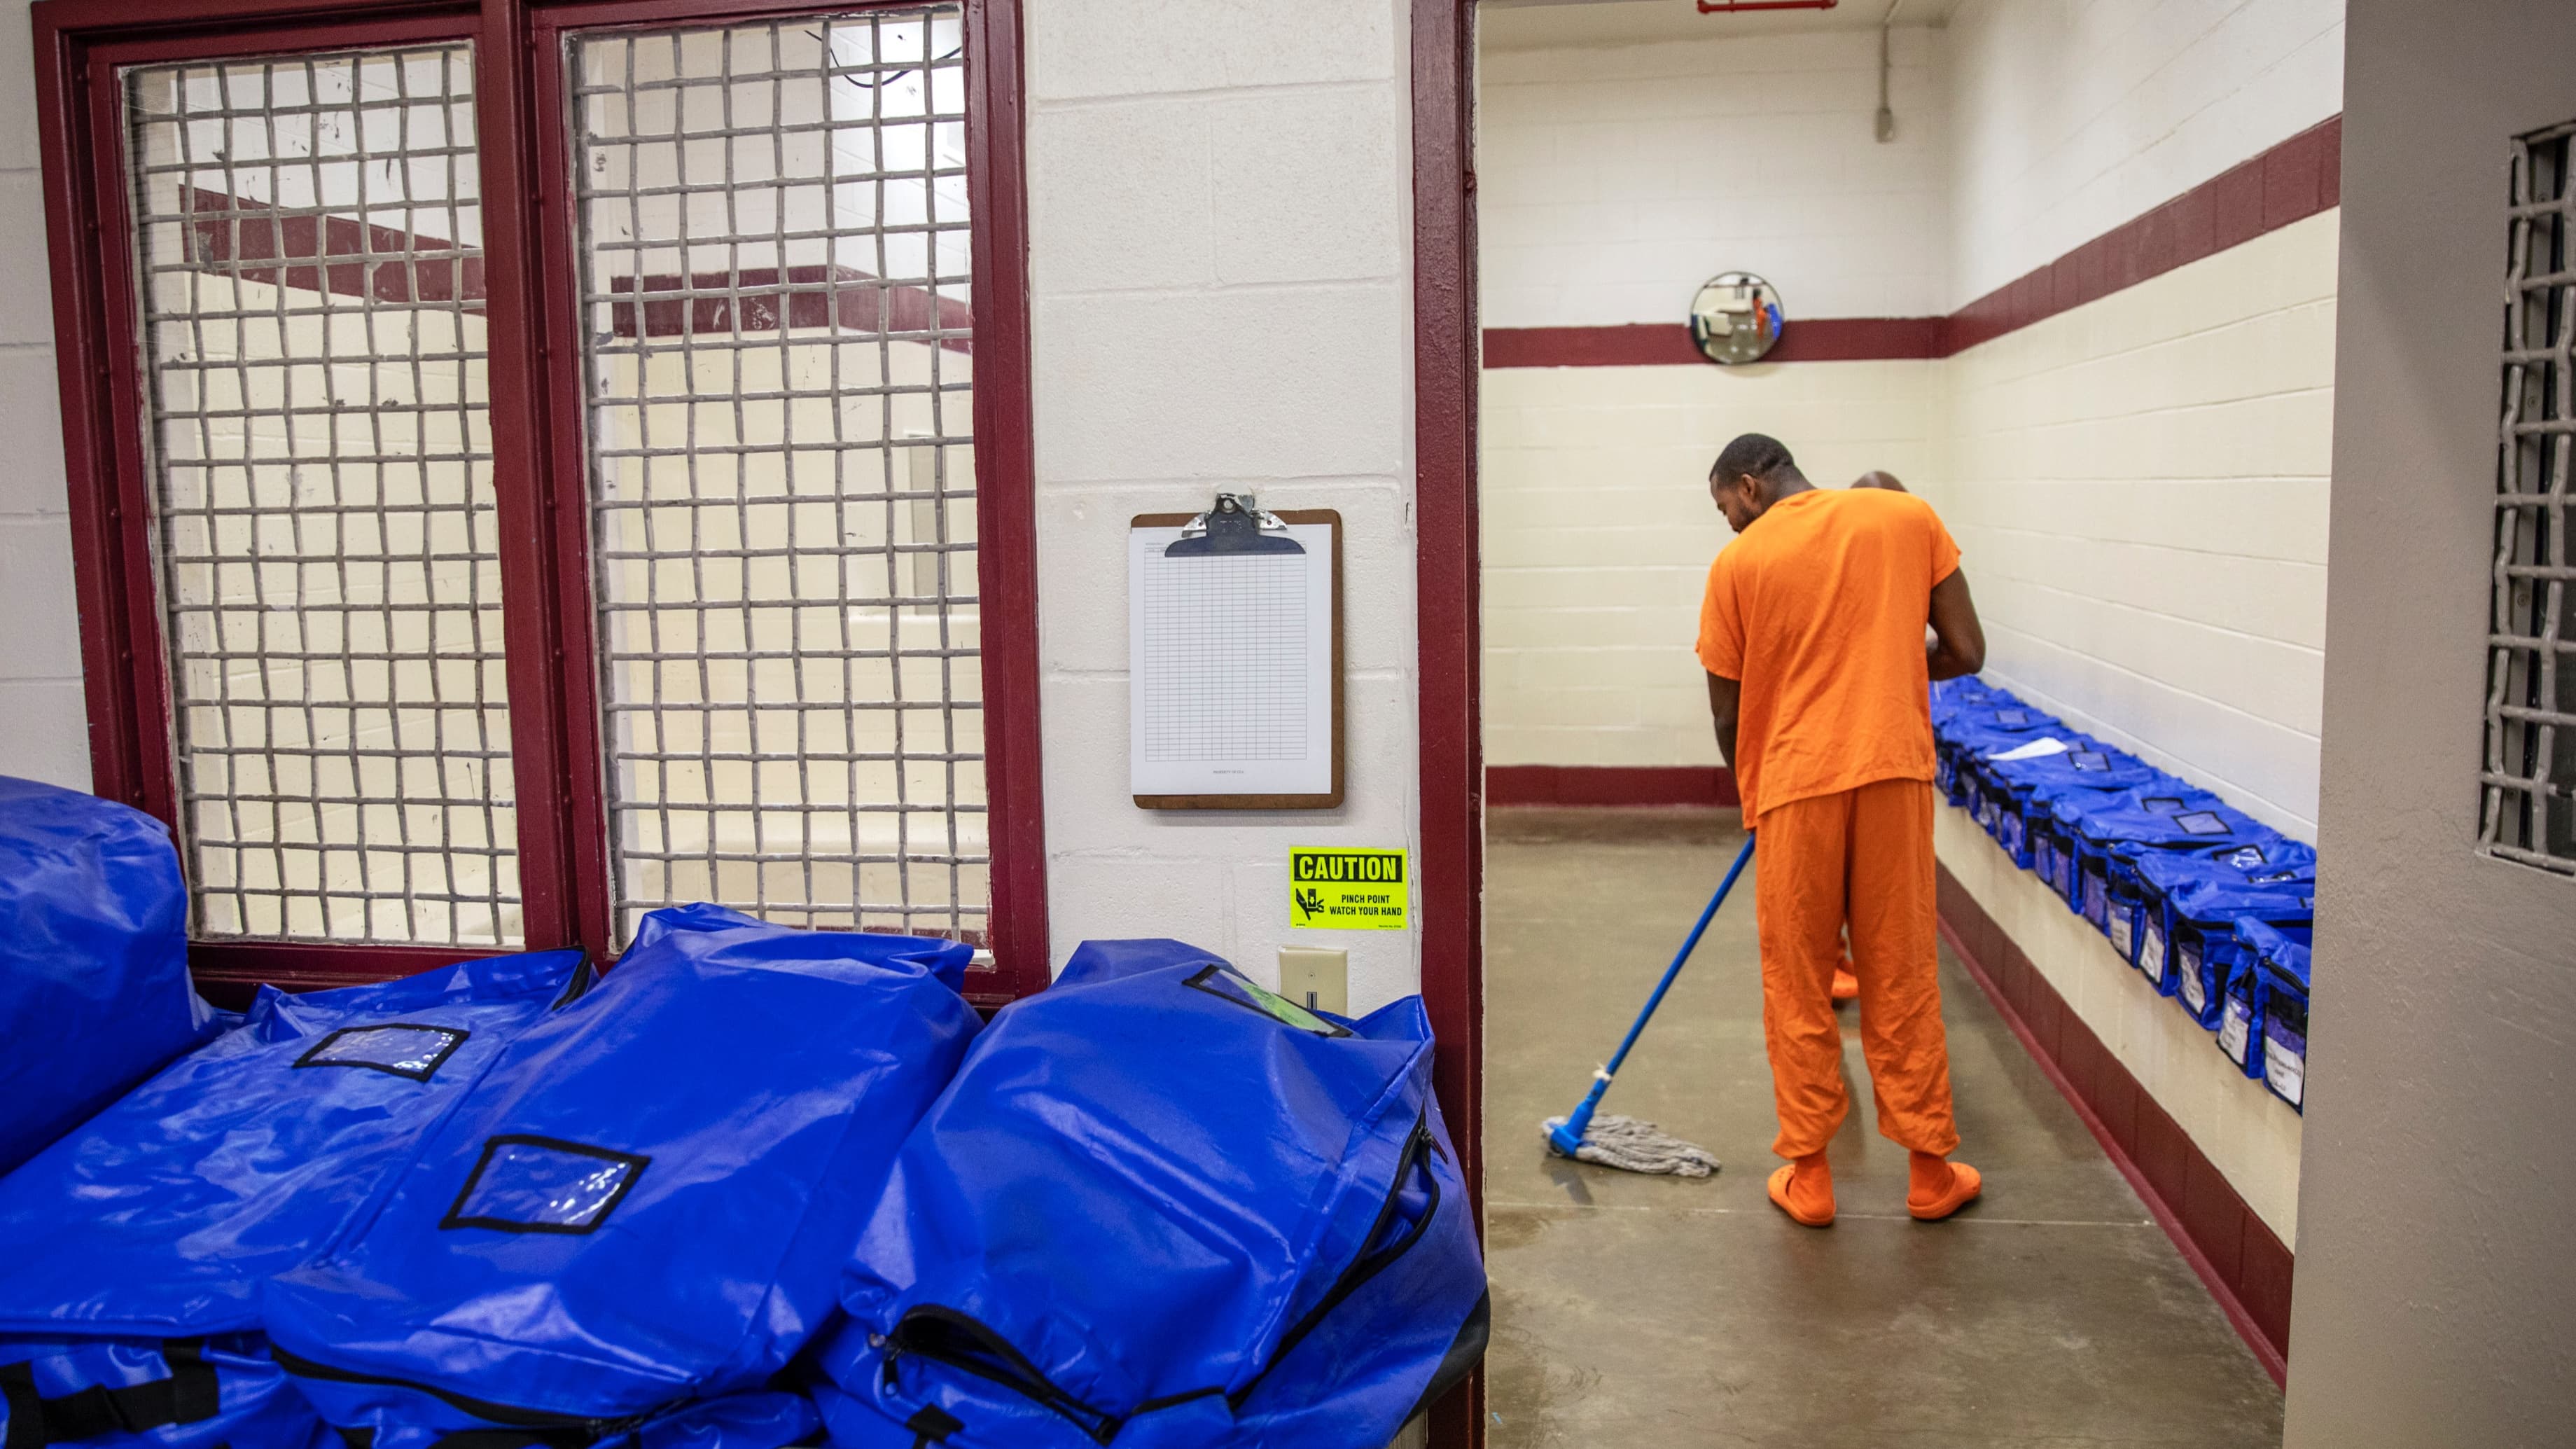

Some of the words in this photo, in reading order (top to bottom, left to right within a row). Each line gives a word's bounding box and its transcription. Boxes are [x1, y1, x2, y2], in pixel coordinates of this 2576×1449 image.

[1299, 856, 1396, 880] CAUTION
[1342, 894, 1365, 903] PINCH
[1367, 894, 1390, 904] POINT
[1330, 906, 1356, 915] WATCH
[1358, 906, 1379, 915] YOUR
[1381, 907, 1402, 916] HAND
